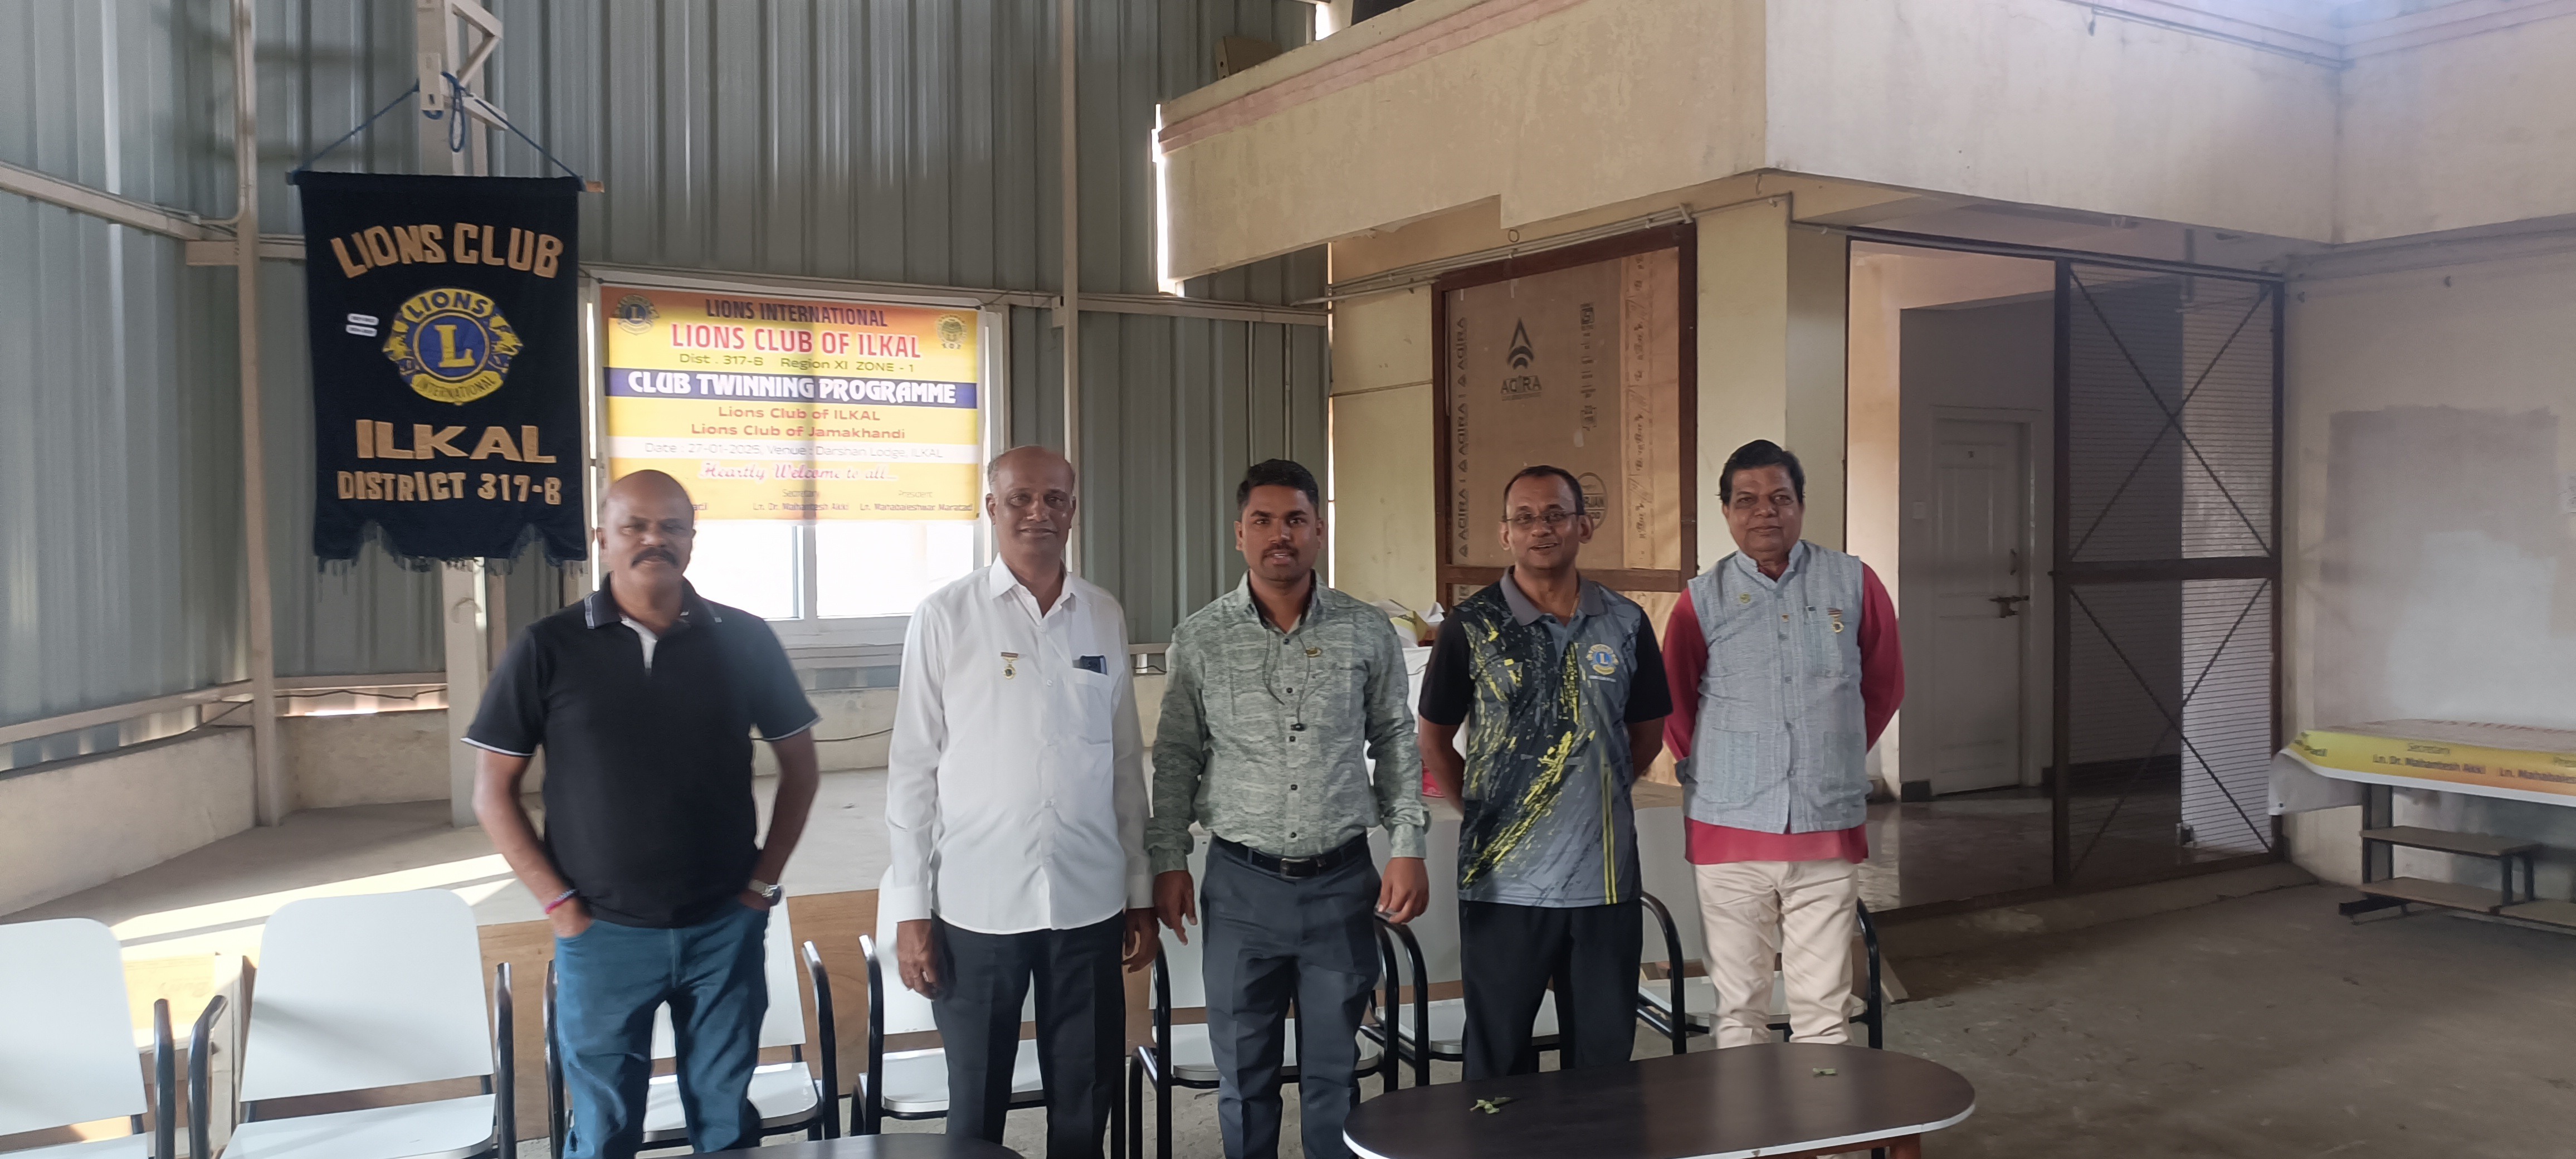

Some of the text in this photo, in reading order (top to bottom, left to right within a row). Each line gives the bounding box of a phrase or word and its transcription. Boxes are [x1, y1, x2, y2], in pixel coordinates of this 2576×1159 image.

[330, 222, 564, 279] LIONS CLUB
[405, 291, 489, 319] LIONS
[705, 299, 889, 327] LIONS INTERNATIONAL
[434, 324, 475, 368] L
[672, 324, 921, 358] LIONS CLUB OF ILKAL
[780, 358, 830, 371] Region
[834, 360, 848, 369] XI
[856, 361, 894, 372] ZONE
[628, 371, 957, 404] CLUB TWINNING PROGRAMME
[719, 406, 881, 421] Lions Club of ILKAL
[356, 419, 557, 463] ILKAL
[691, 423, 905, 439] Lions Club of Jamakhandi
[816, 446, 867, 456] Darshan
[911, 449, 944, 458] ILKAL
[337, 471, 562, 505] DISTRICT 317-B
